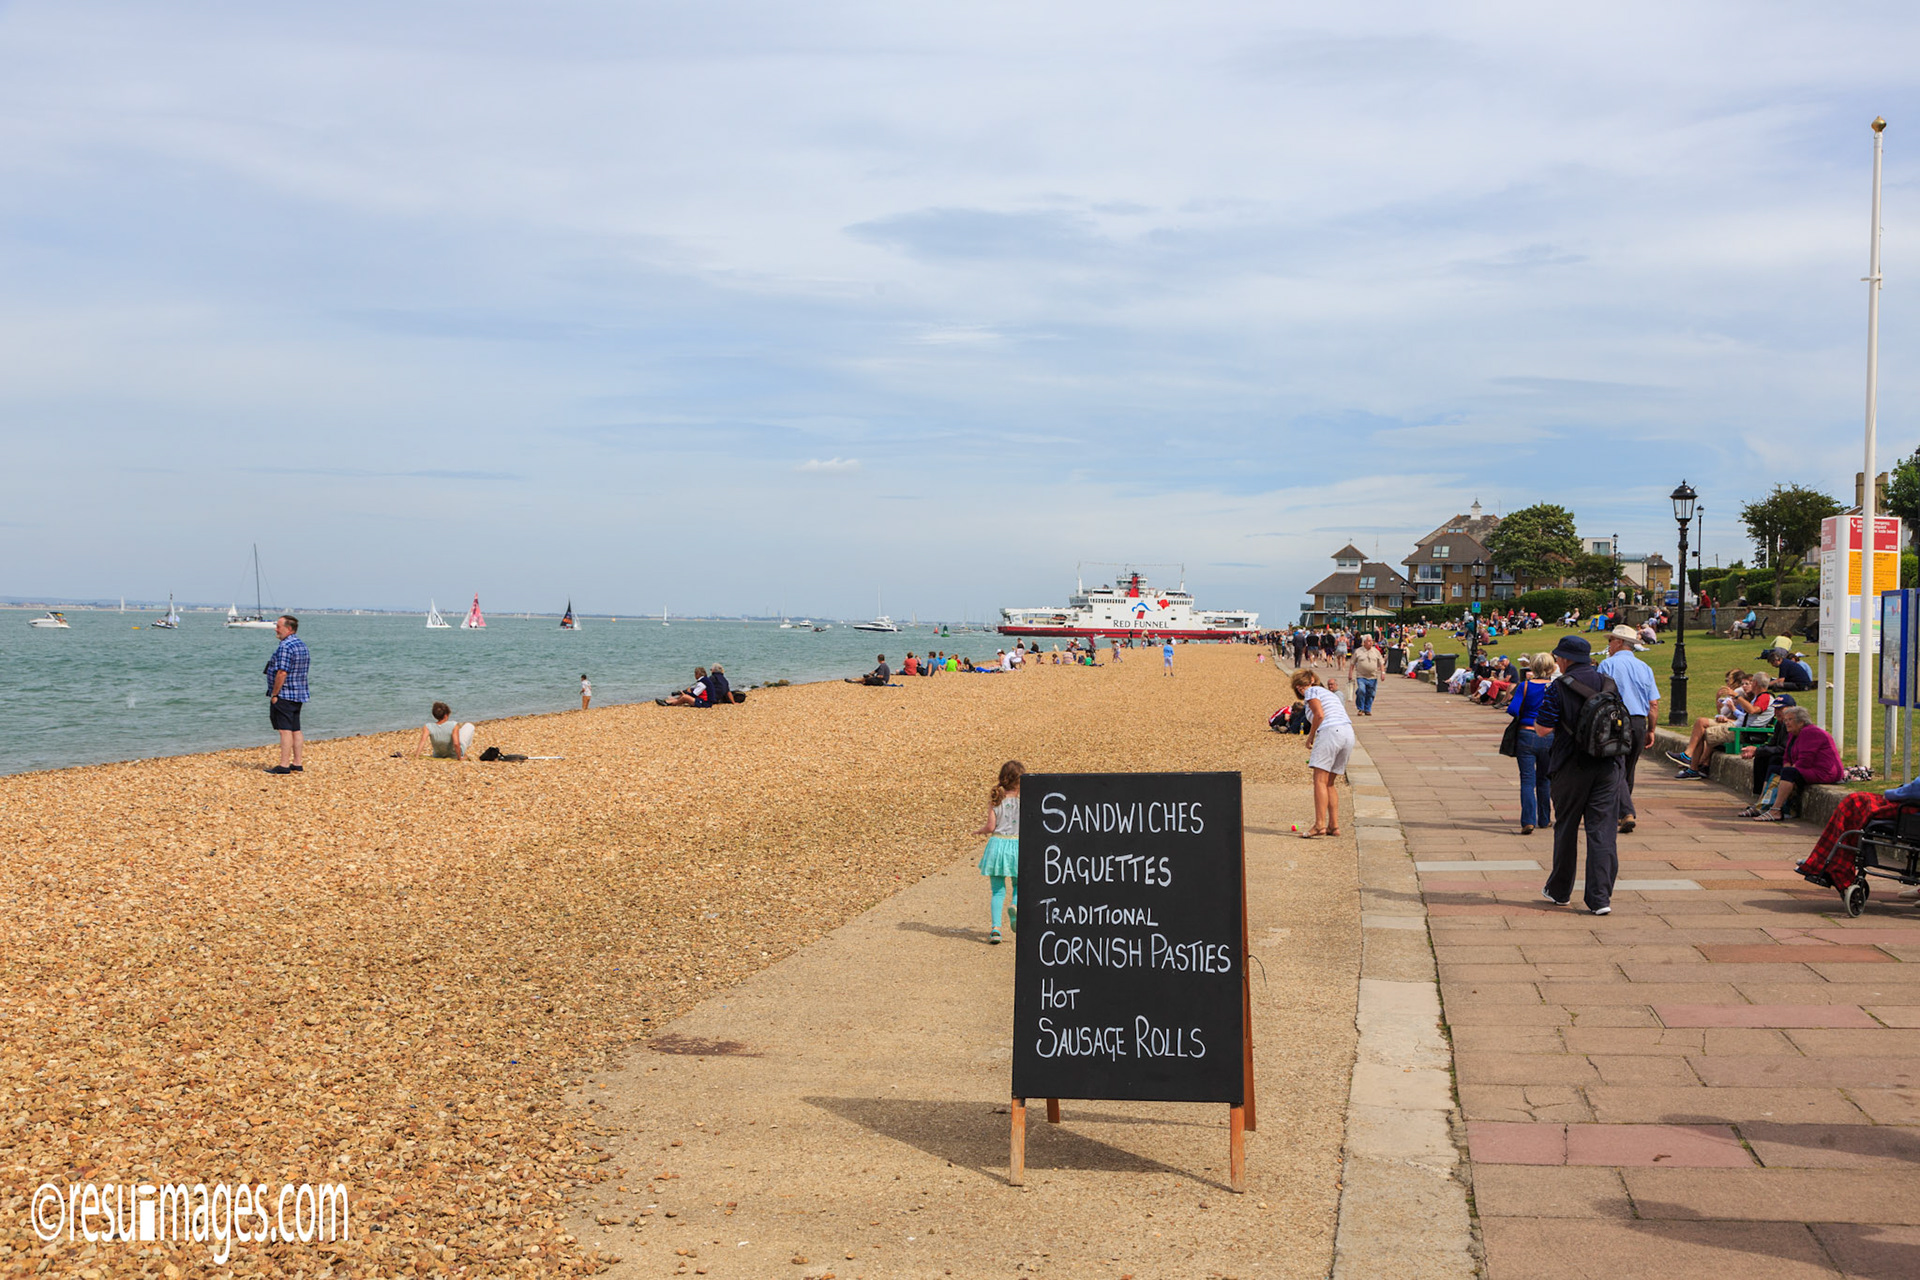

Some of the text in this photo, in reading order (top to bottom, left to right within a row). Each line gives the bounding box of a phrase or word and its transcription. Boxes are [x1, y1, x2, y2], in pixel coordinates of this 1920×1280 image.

[1113, 620, 1169, 629] RED FUNNEL
[1041, 792, 1204, 834] SANDWICHES
[1044, 845, 1172, 887] BAGUETTES
[1039, 897, 1159, 926] TRADITIONAL
[1039, 931, 1231, 973] CORNISH PASTIES
[1041, 978, 1081, 1010] HOT
[1036, 1015, 1206, 1062] SAUSAGE ROLLS
